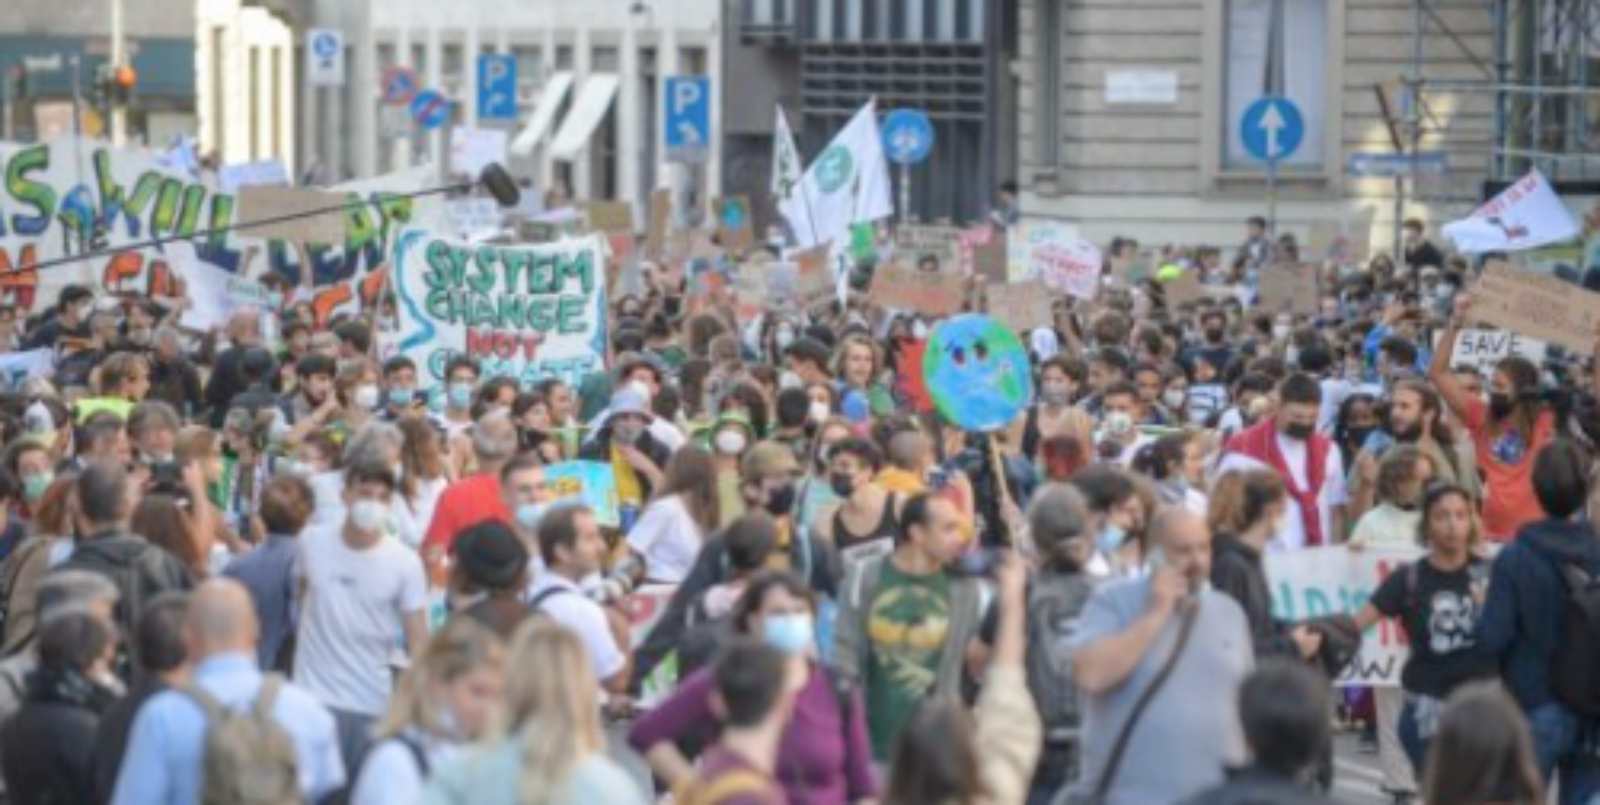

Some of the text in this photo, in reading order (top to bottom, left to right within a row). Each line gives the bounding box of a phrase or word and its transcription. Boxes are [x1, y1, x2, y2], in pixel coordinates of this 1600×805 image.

[485, 61, 507, 90] P
[674, 82, 701, 114] P
[423, 240, 594, 294] SYSTEM
[426, 288, 589, 334] CHANGE
[466, 327, 545, 360] NOT
[1461, 332, 1522, 355] SAVE
